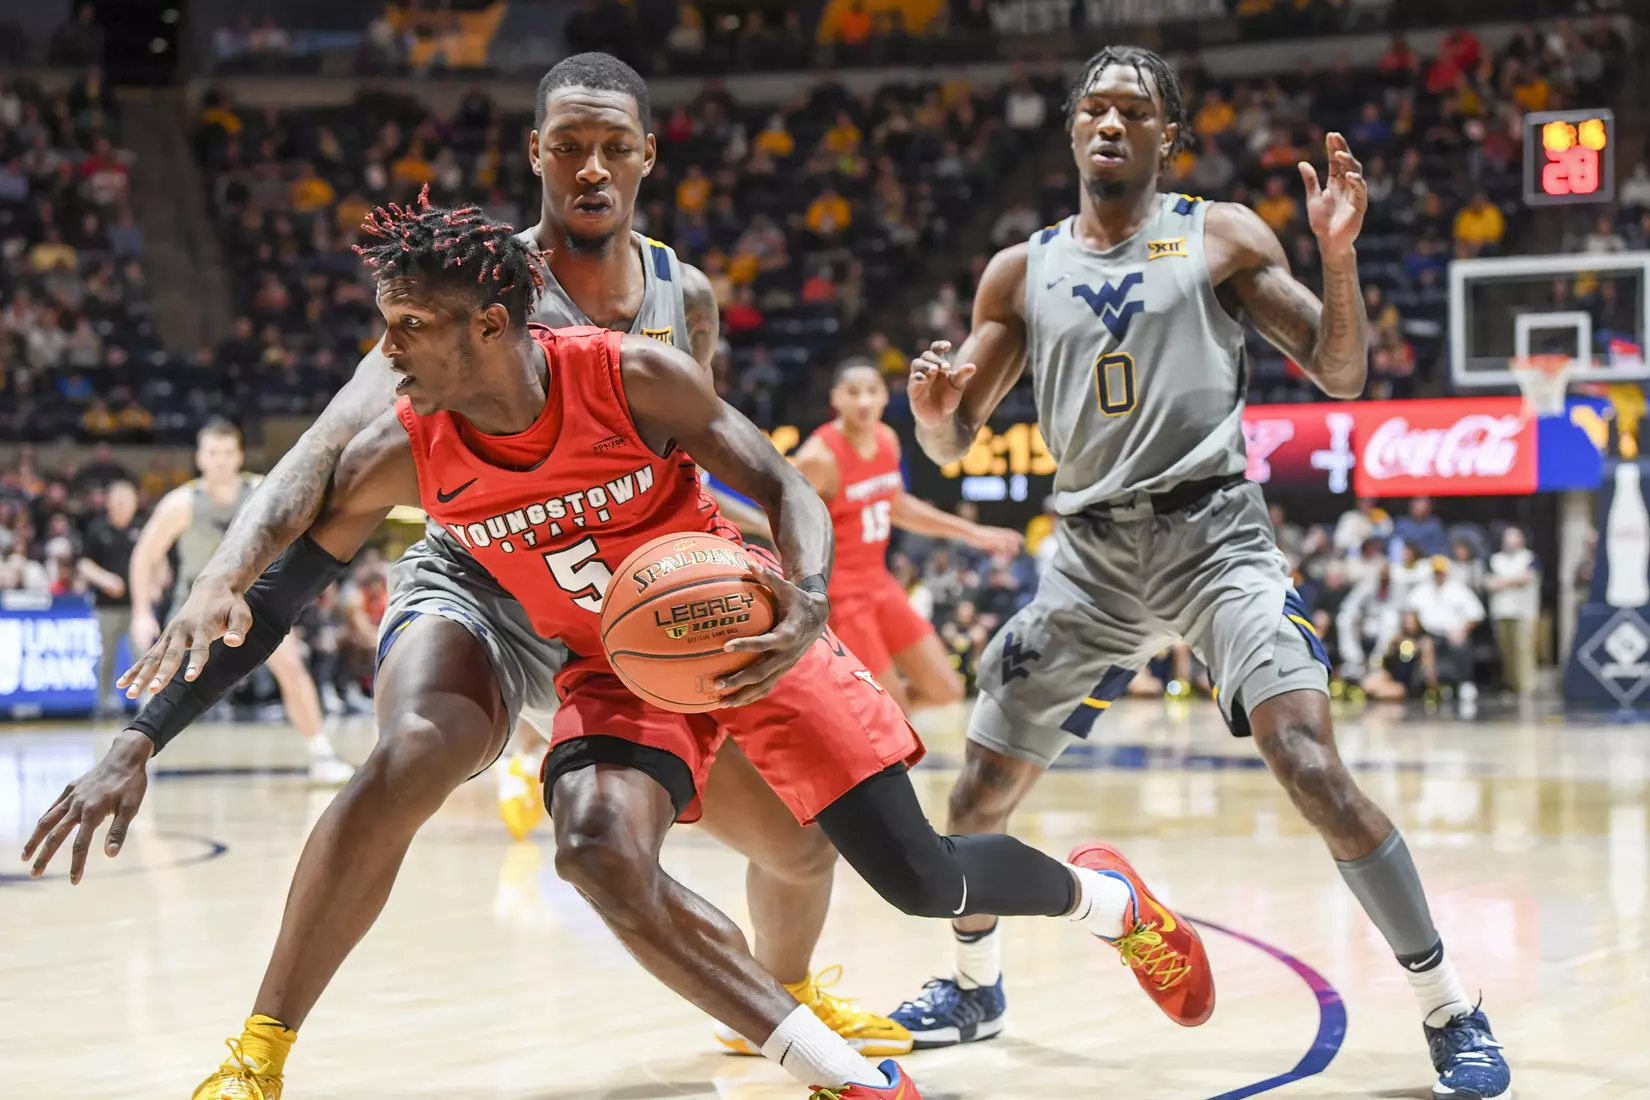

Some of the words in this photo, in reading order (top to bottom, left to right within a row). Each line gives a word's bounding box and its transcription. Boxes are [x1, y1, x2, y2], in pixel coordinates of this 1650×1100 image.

[1095, 352, 1139, 417] 0
[447, 463, 655, 549] YOUNGSTOWN
[861, 500, 891, 543] 15
[541, 534, 613, 614] 5
[631, 547, 752, 595] SPALDING
[654, 592, 755, 627] LEGACY
[691, 613, 750, 633] 1000
[711, 630, 726, 638] GAME
